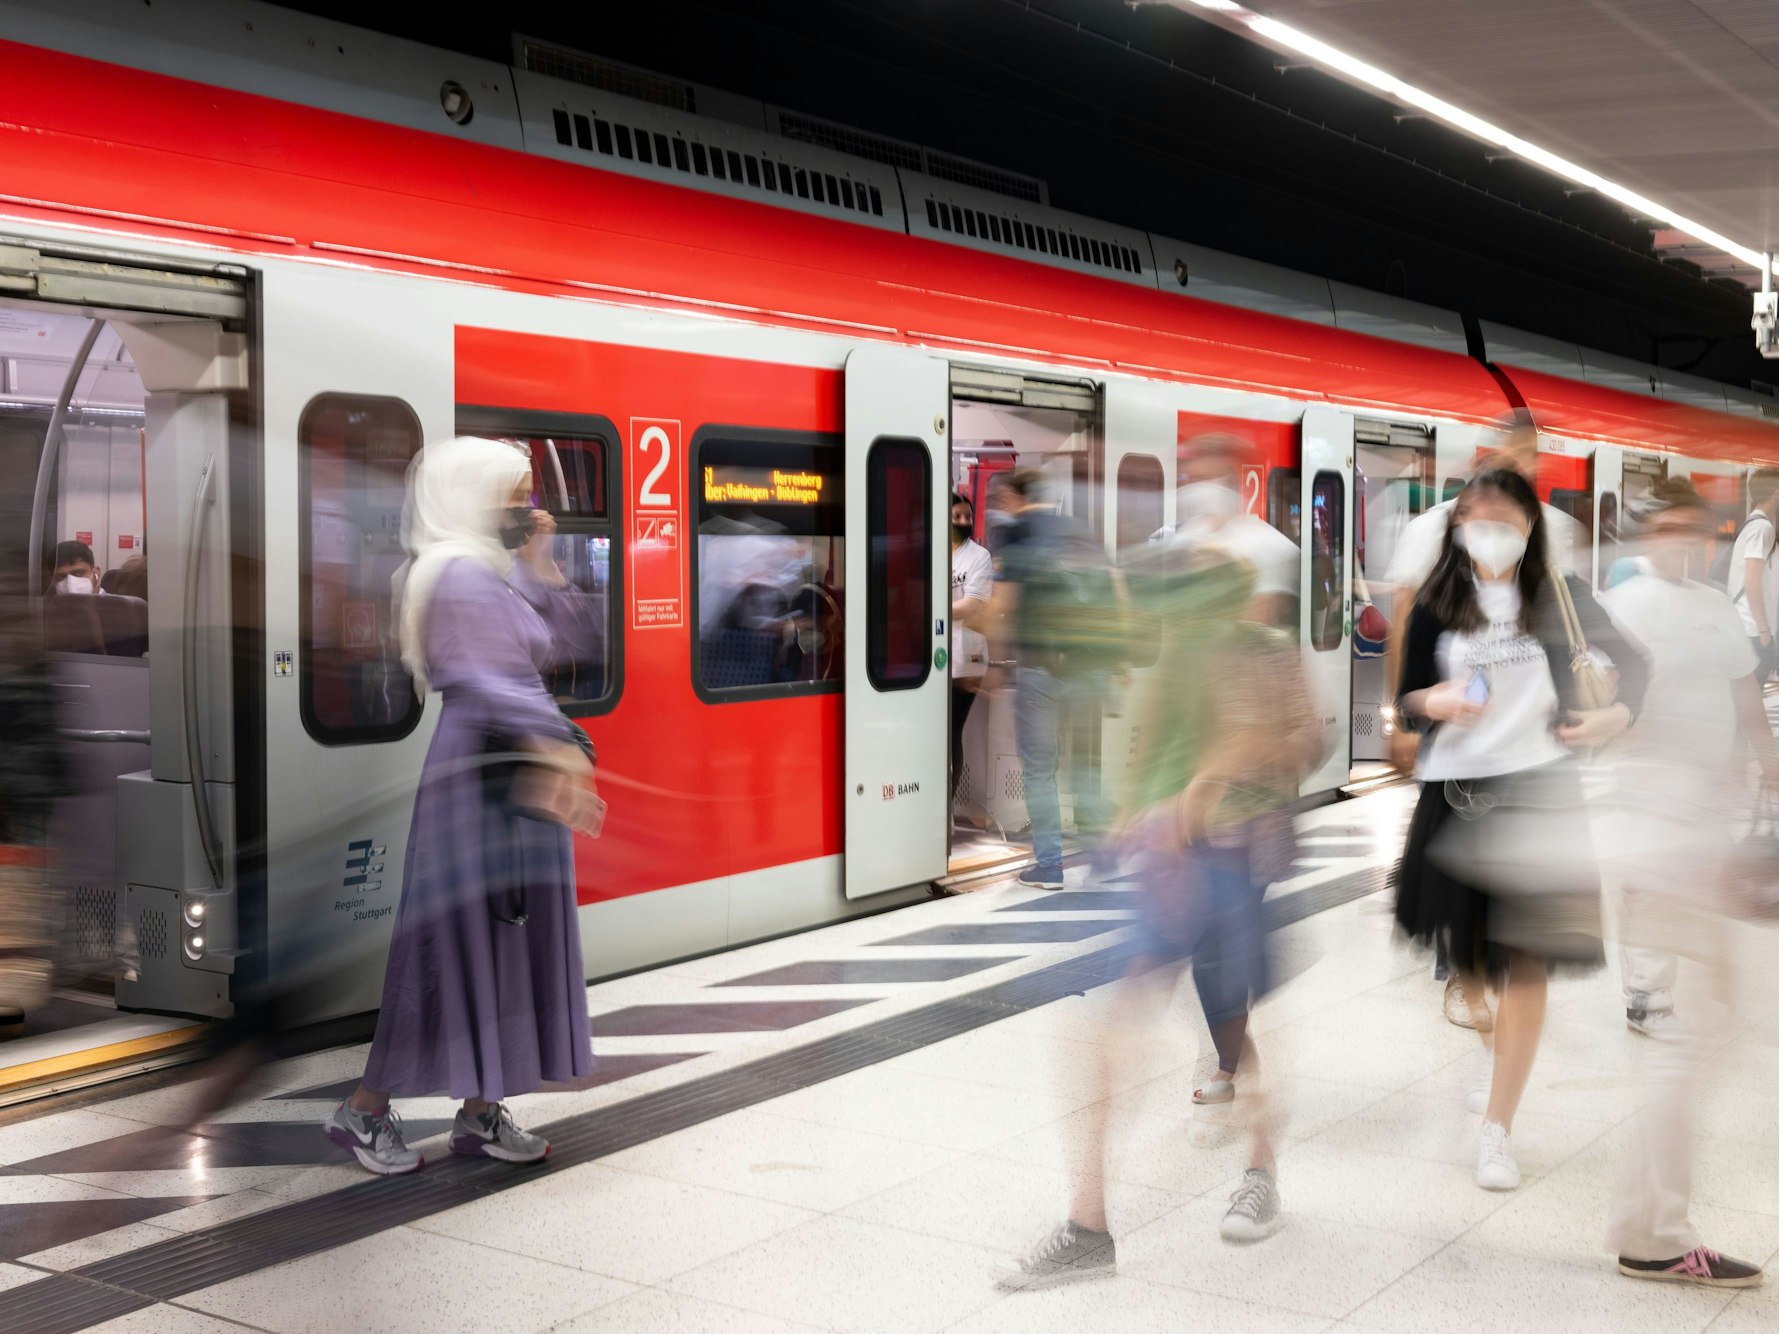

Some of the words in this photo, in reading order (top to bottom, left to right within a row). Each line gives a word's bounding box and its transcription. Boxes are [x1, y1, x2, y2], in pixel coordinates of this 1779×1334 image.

[639, 426, 671, 505] 2
[773, 470, 822, 490] Herrenberg
[727, 482, 769, 502] Vaihingen
[776, 485, 818, 504] Böblingen
[1246, 469, 1260, 520] 2
[882, 783, 895, 799] DB
[898, 782, 920, 795] BAHN
[334, 898, 365, 912] Region
[353, 905, 392, 921] Stuttgart
